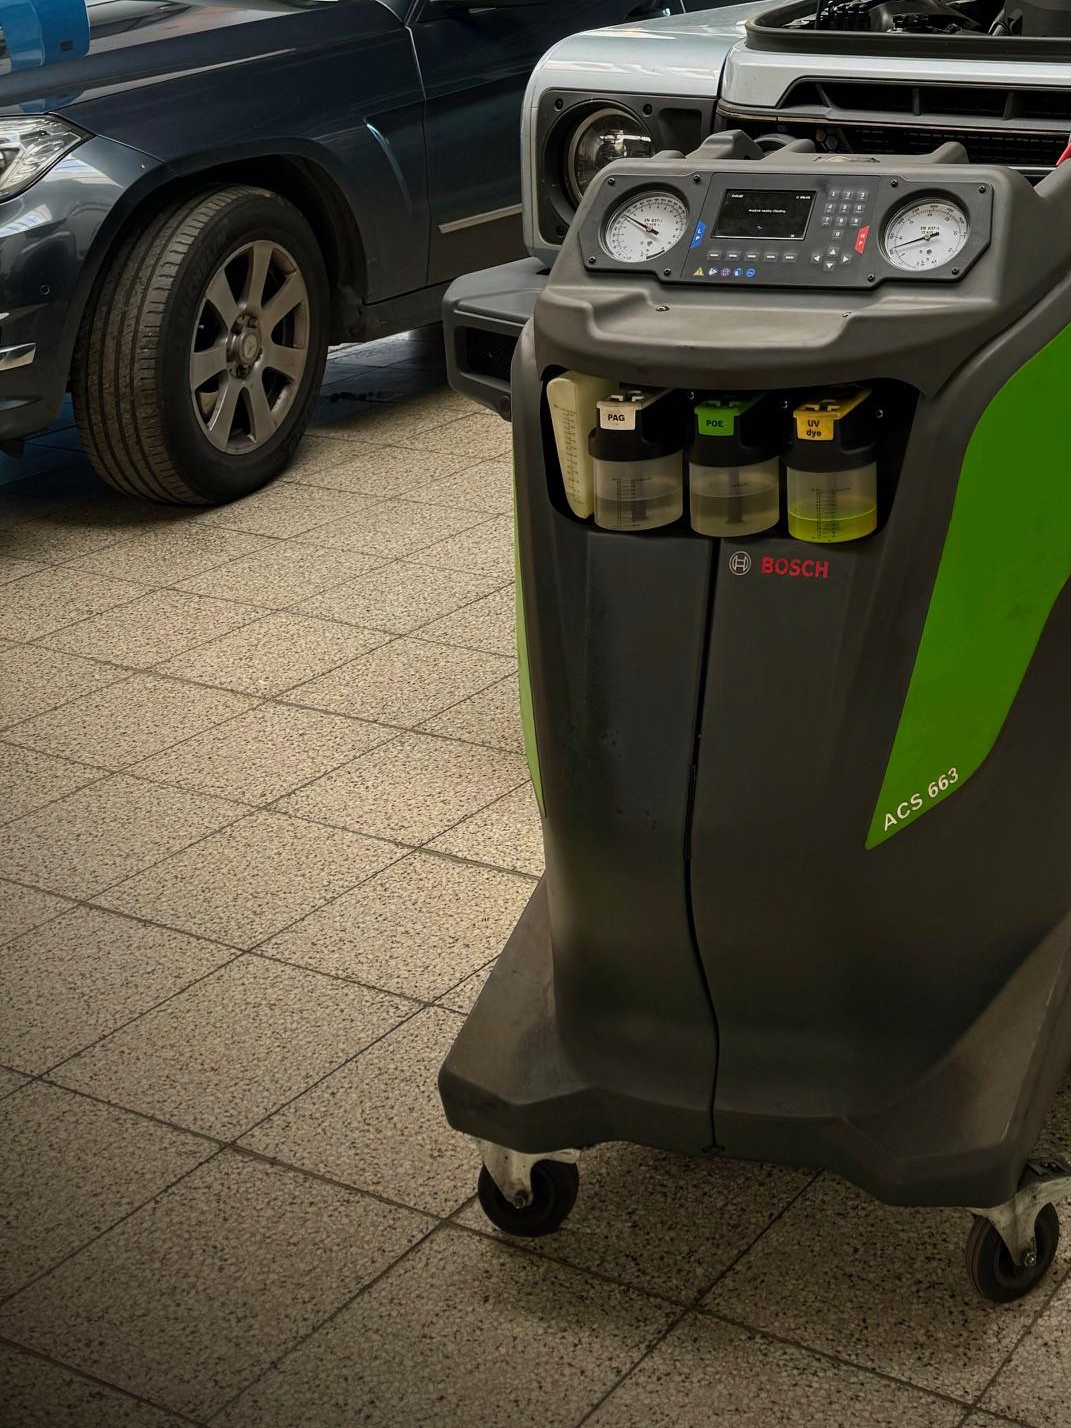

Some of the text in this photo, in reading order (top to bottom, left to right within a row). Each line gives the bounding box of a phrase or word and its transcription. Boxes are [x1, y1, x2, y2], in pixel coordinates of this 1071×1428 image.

[607, 413, 626, 422] PAG
[706, 419, 724, 428] POE
[807, 419, 820, 428] UV
[806, 428, 822, 437] dye
[760, 555, 830, 580] BOSCH
[884, 767, 959, 832] ACS 663
